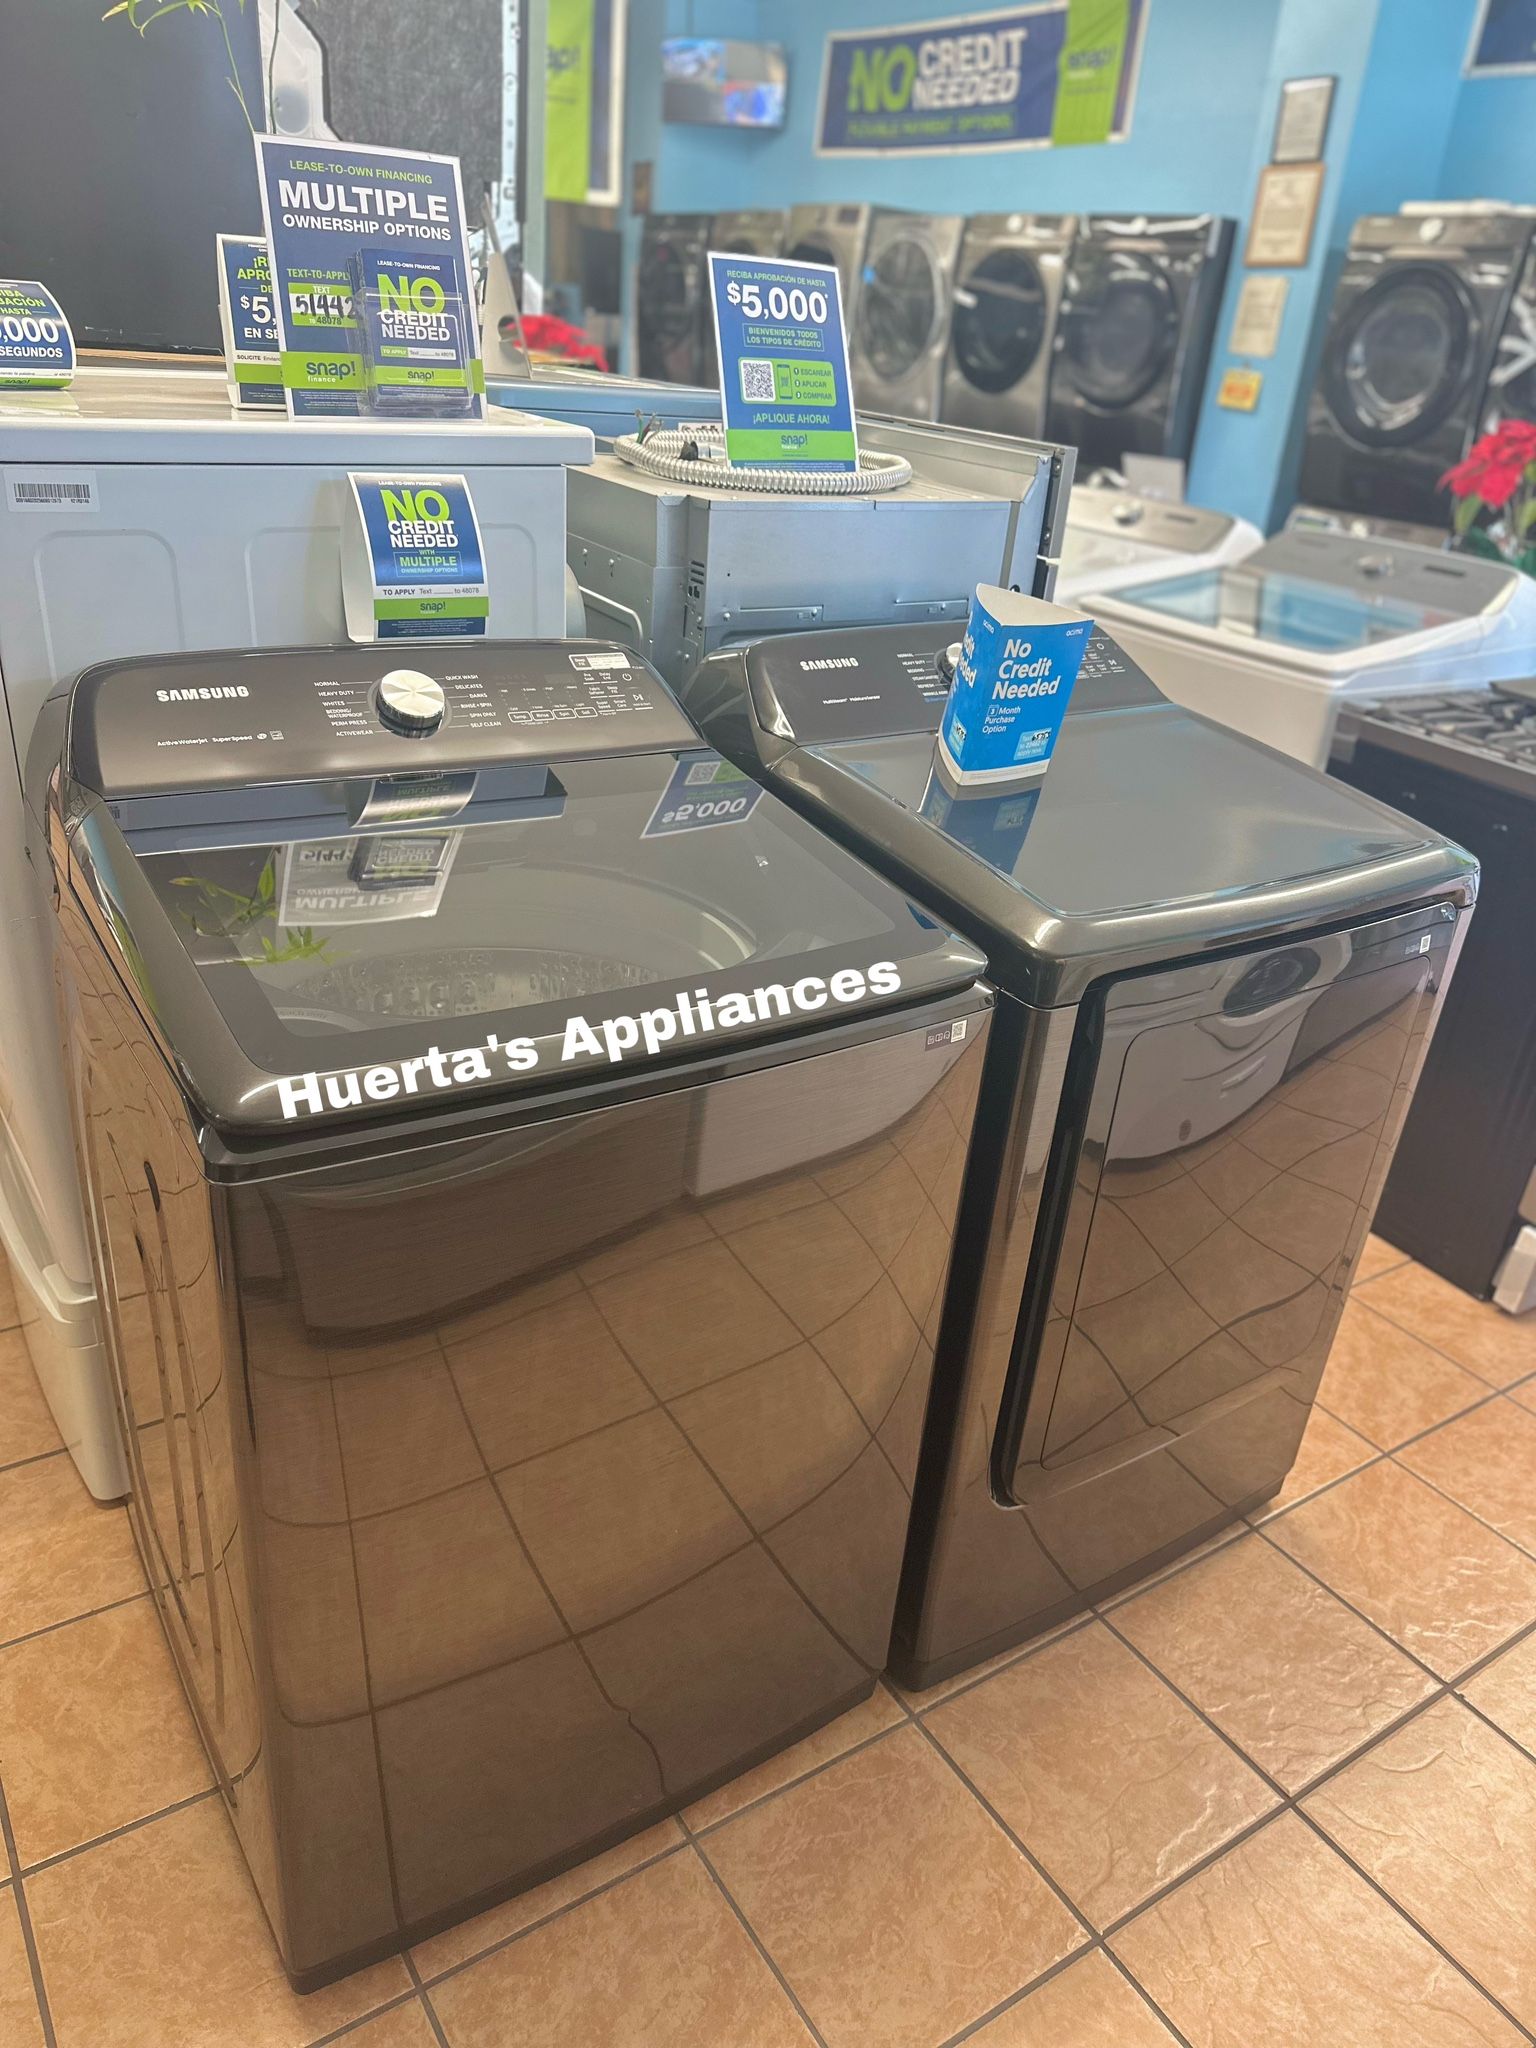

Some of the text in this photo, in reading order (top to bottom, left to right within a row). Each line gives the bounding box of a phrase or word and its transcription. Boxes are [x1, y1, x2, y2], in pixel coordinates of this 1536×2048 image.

[918, 27, 1028, 77] CREDIT
[846, 43, 917, 112] NO
[912, 69, 1020, 110] NEEDED
[289, 160, 433, 185] LEASE-TO-OWN FINANCING
[278, 179, 450, 222] MULTIPLE
[283, 214, 451, 241] OWNERSHIP OPTIONS
[377, 260, 441, 271] LEASE-TO-OWN FINANCING
[727, 270, 826, 288] RECIBA APROBACIÓN DE HASTA
[0, 289, 24, 298] IBA
[313, 285, 330, 294] TEXT
[377, 273, 446, 314] NO
[1, 307, 33, 316] HASTA
[296, 293, 359, 321] 51442
[317, 316, 342, 326] 48078
[380, 309, 448, 328] CREDIT
[244, 327, 262, 339] EN
[382, 324, 451, 341] NEEDED
[748, 327, 818, 339] BIENVENIDOS TODOS
[747, 336, 821, 348] LOS TIPOS DE CRÉDITO
[0, 346, 64, 358] SEGUNDOS
[306, 361, 356, 380] snap!
[407, 370, 435, 382] snap!
[802, 380, 827, 388] APLICAR
[753, 413, 830, 425] ¡APLIQUE AHORA!
[781, 433, 808, 448] snap!
[380, 489, 450, 521] NO
[388, 520, 455, 534] CREDIT
[390, 534, 459, 548] NEEDED
[399, 556, 457, 567] MULTIPLE
[420, 601, 446, 613] snap!
[1065, 627, 1084, 637] acima
[1003, 638, 1032, 658] No
[800, 657, 859, 671] SAMSUNG
[998, 657, 1053, 679] Credit
[156, 685, 250, 702] SAMSUNG
[992, 676, 1061, 700] Needed
[999, 705, 1021, 715] Month
[984, 716, 1016, 724] Purchase
[982, 725, 1007, 735] Option
